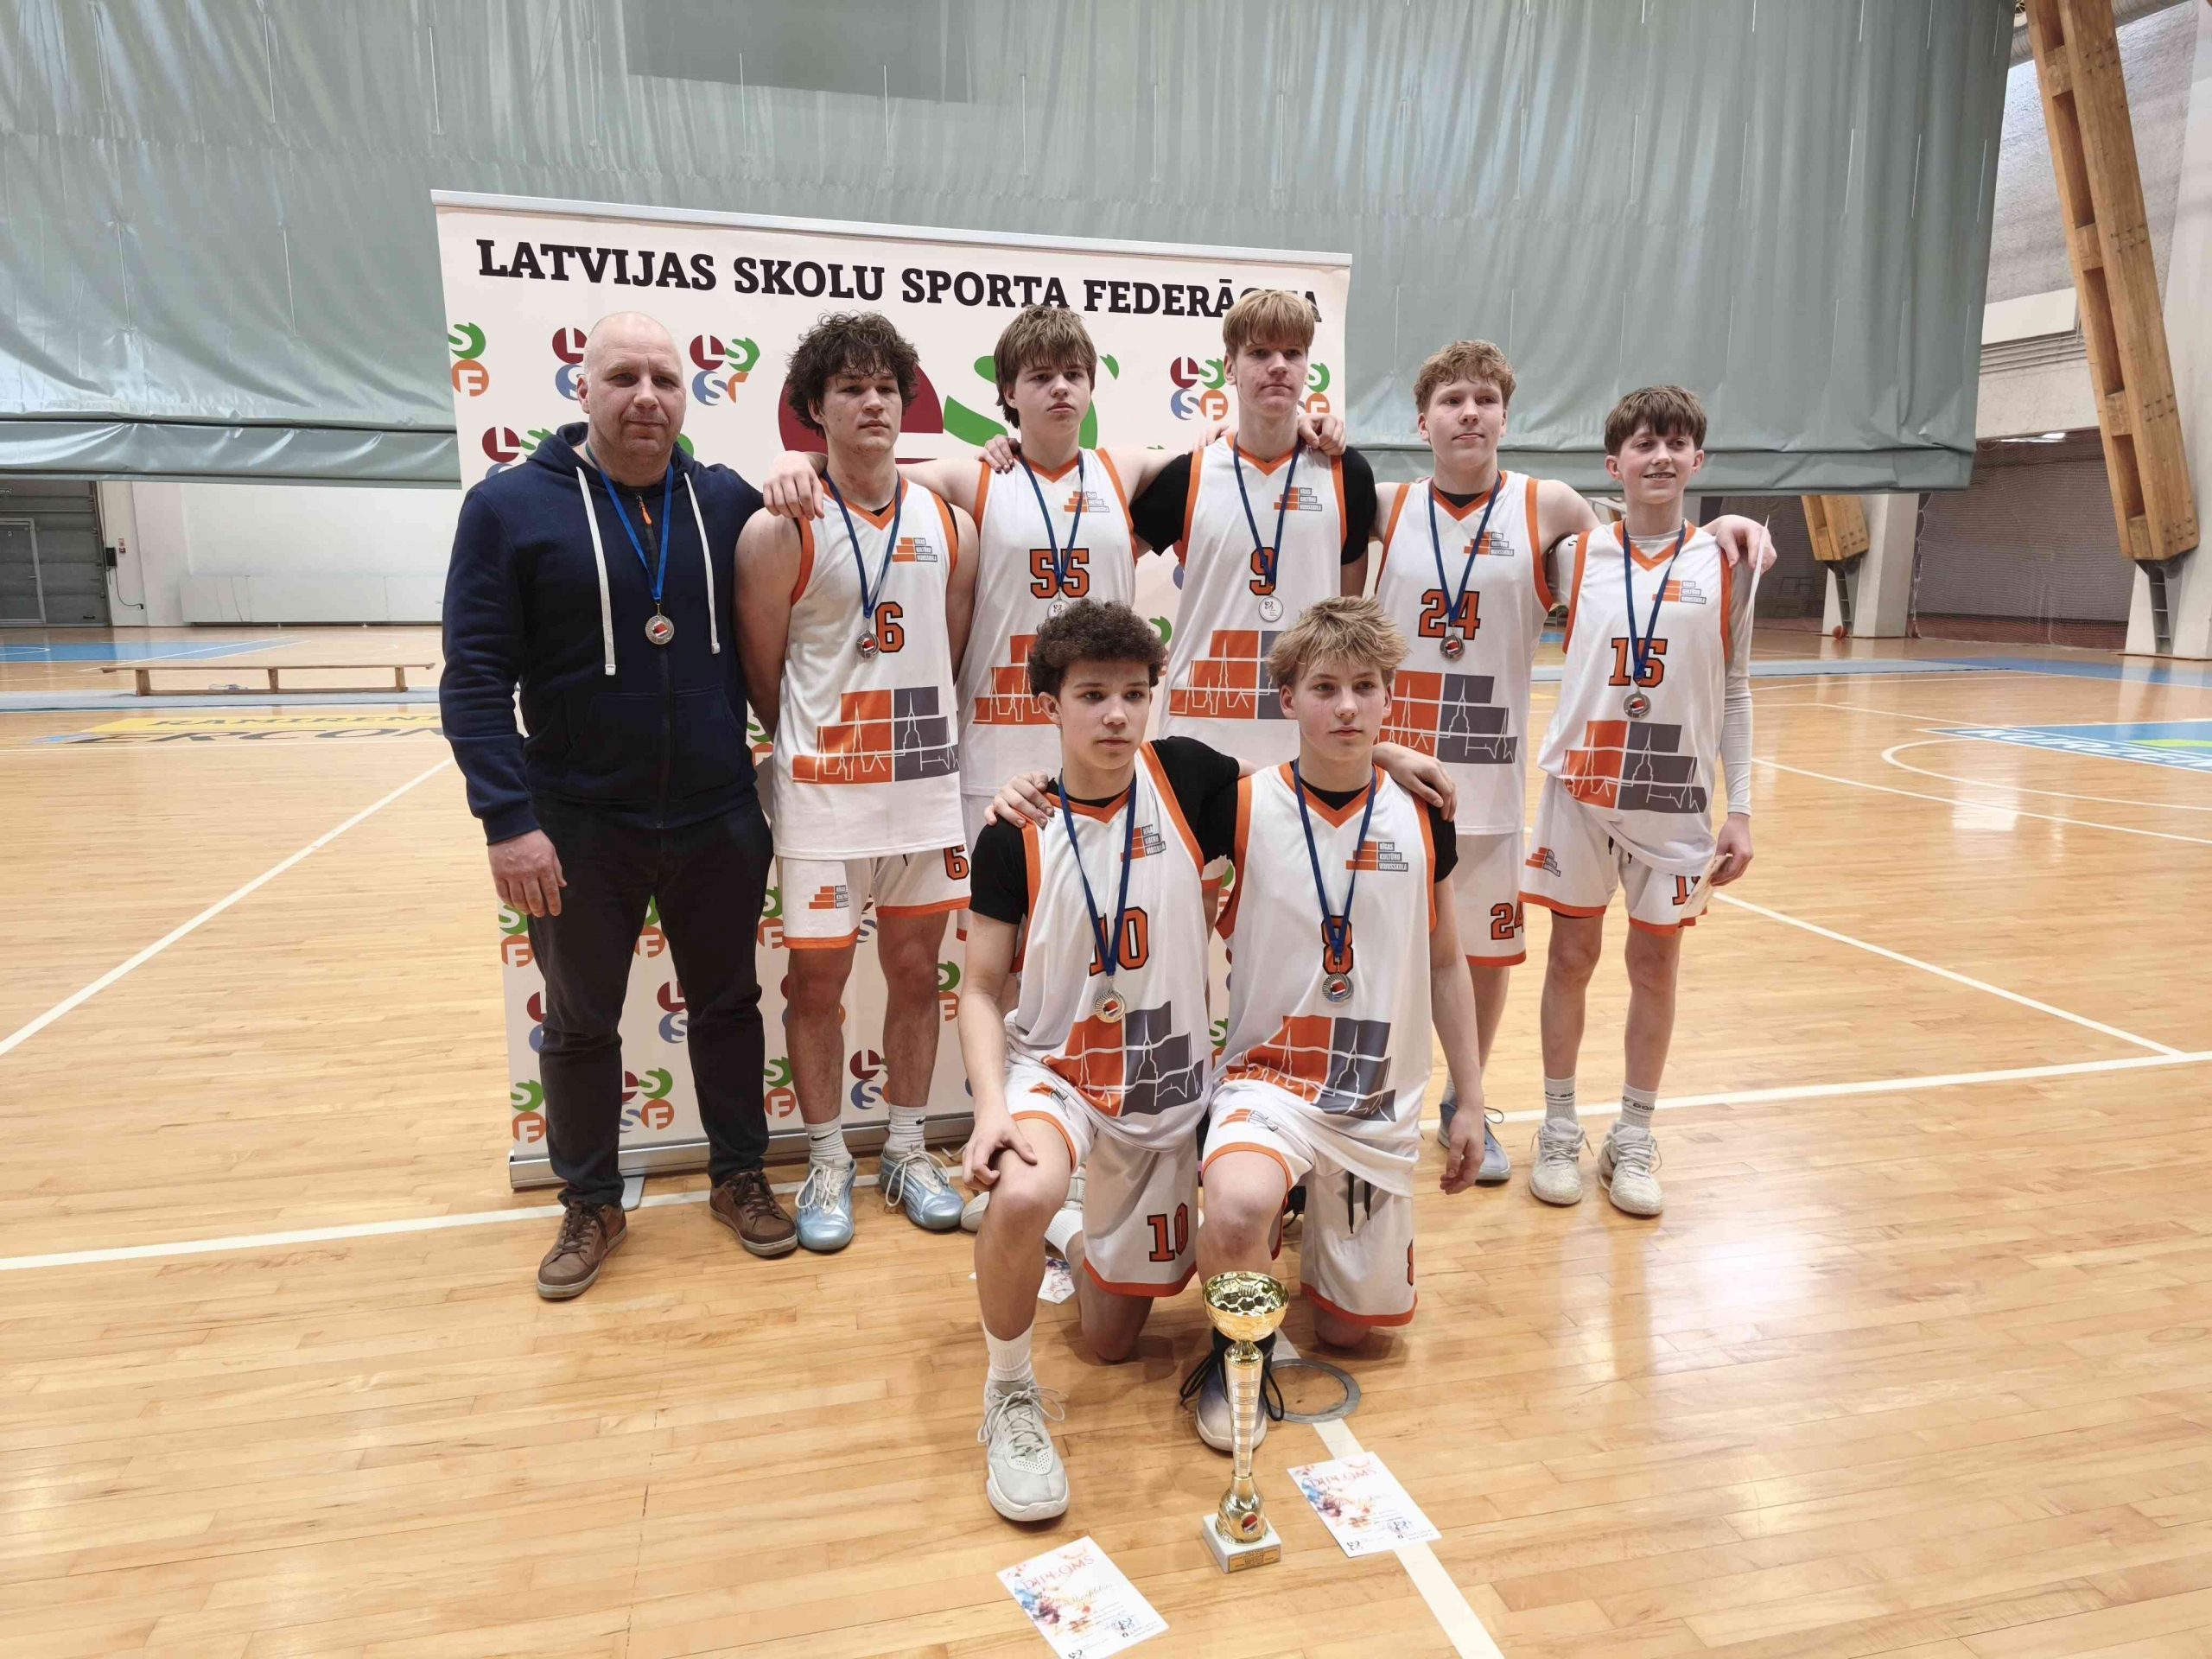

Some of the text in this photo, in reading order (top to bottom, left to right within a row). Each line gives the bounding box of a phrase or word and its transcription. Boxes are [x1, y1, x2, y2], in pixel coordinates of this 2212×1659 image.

[476, 239, 1322, 322] LATVIJAS SKOLU SPORTA FEDERĀA
[1029, 548, 1090, 599] 55
[1249, 547, 1276, 596] 9
[875, 601, 905, 653] 6
[1418, 588, 1480, 640] 24
[1608, 637, 1668, 688] 15
[943, 844, 969, 880] 6
[1672, 875, 1700, 906] 1
[1089, 906, 1149, 976] 10
[1321, 915, 1353, 975] 8
[1147, 1202, 1189, 1262] 10
